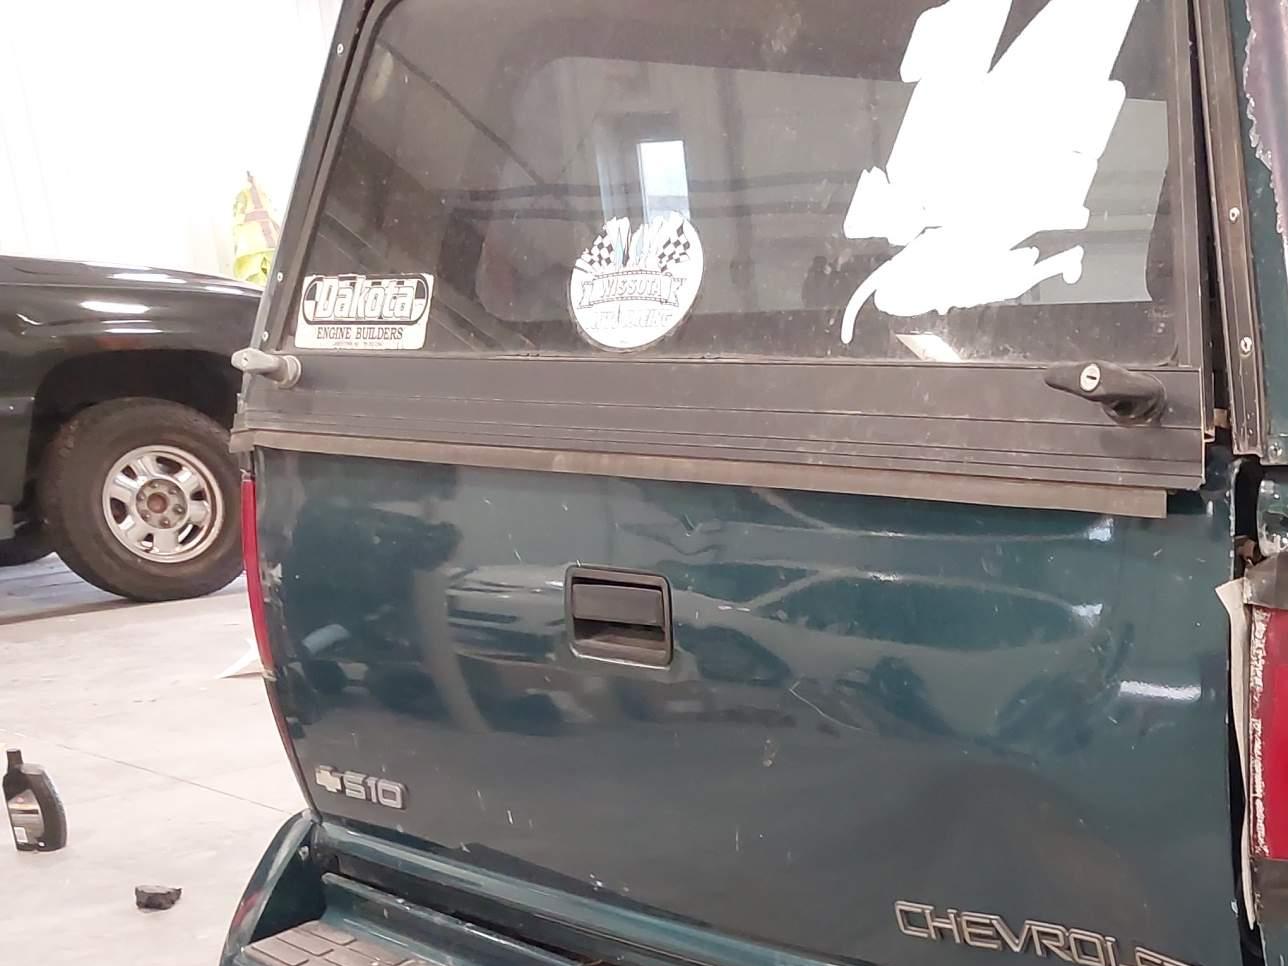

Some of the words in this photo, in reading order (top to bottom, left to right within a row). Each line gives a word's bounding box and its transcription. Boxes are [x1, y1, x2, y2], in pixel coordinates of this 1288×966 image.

[313, 275, 414, 320] Dakota
[317, 326, 352, 340] ENGINE
[355, 326, 404, 341] BUILDERS
[343, 770, 405, 809] S10
